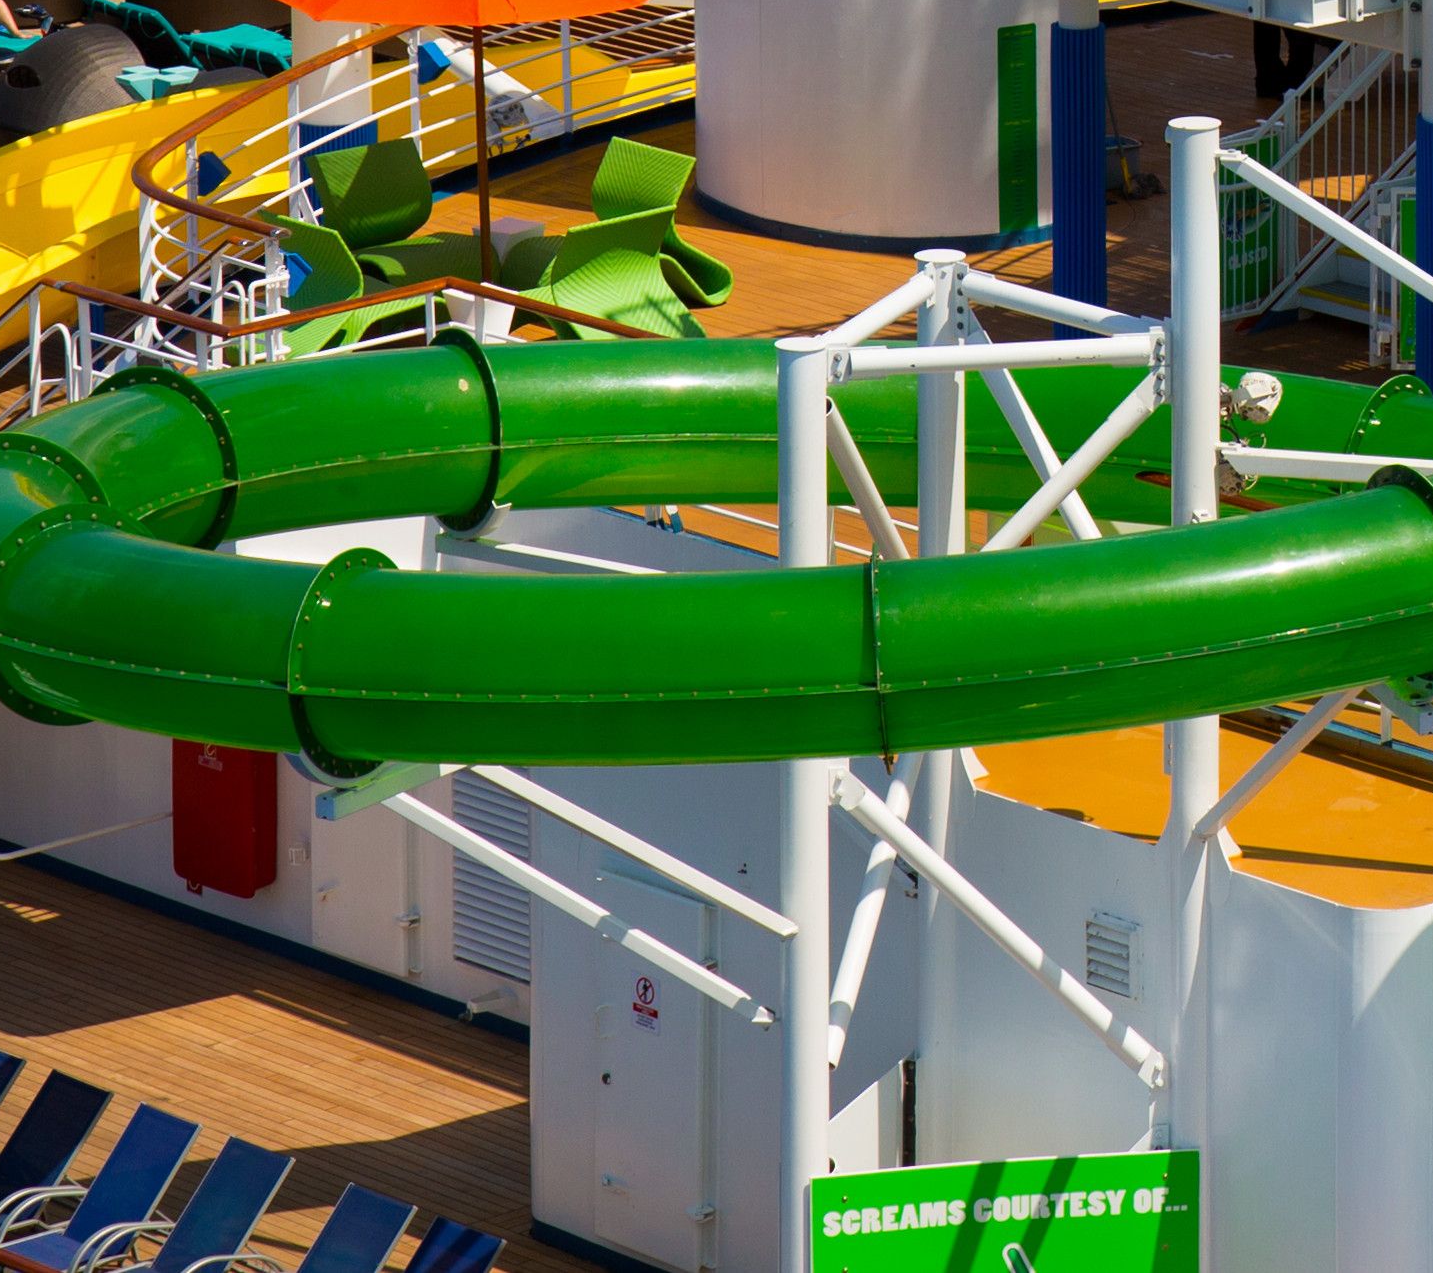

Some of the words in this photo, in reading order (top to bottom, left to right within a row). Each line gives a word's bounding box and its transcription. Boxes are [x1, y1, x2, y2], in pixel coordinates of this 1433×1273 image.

[823, 1200, 967, 1238] SCREAMS
[973, 1189, 1127, 1223] COURTESY
[1132, 1187, 1189, 1214] OF...
